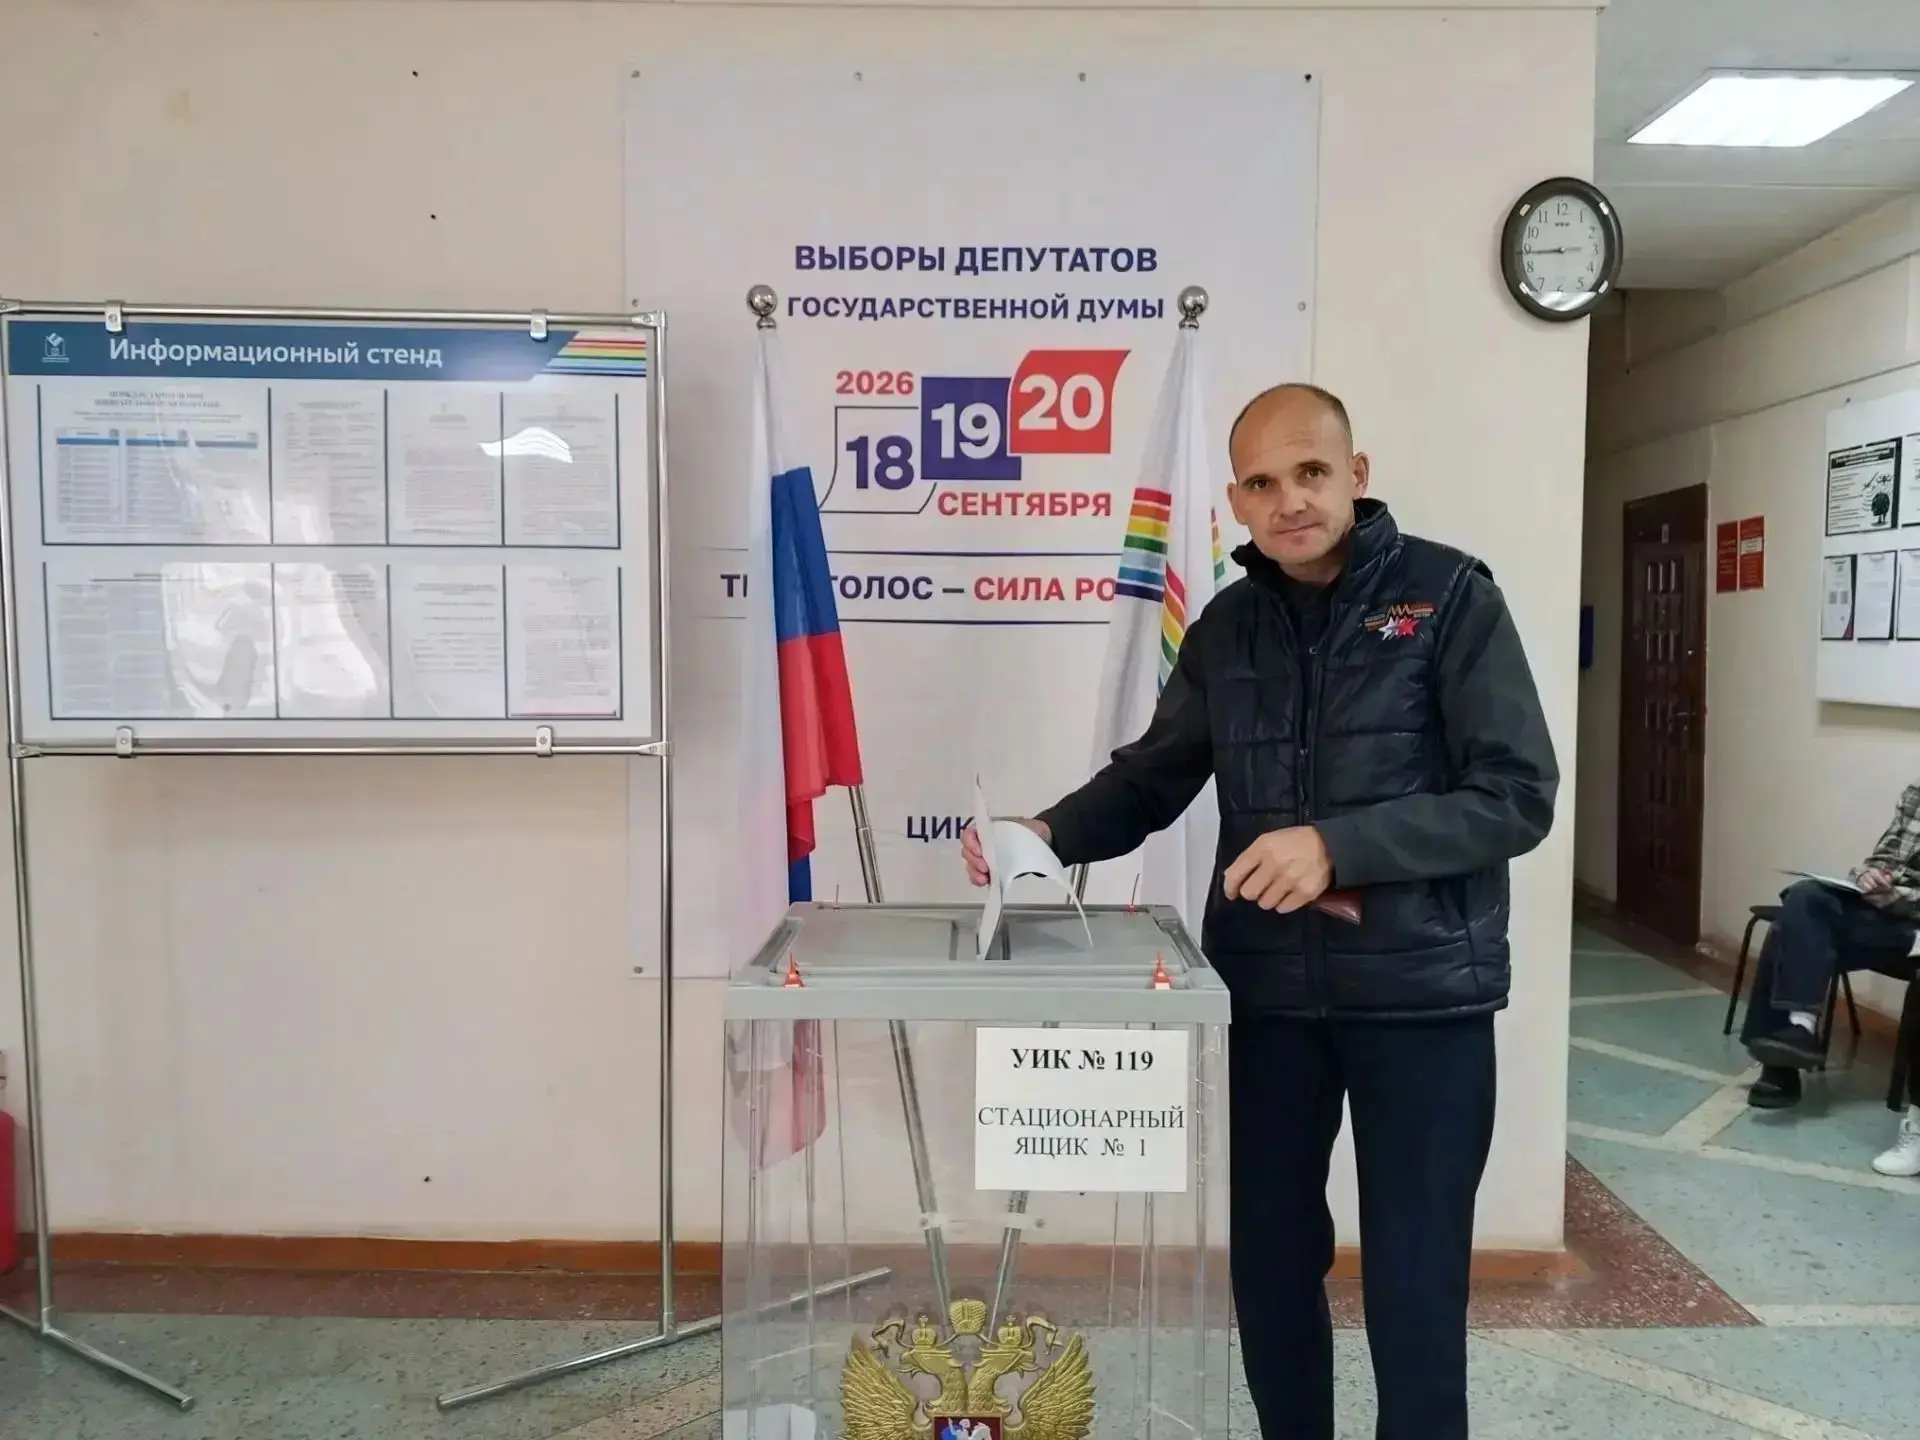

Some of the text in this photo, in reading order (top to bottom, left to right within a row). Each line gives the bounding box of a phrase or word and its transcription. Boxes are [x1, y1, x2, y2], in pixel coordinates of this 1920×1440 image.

[1556, 202, 1571, 216] 12
[795, 245, 1158, 276] ВЫБОРЫ ДЕПУТАТОВ
[787, 294, 1164, 323] ГОСУДАРСТВЕННОЙ ДУМЫ
[108, 333, 444, 370] Информационный стенд
[835, 370, 914, 396] 2026
[846, 373, 1105, 490] 18 19 20
[937, 492, 1111, 517] СЕНТЯБРЯ
[974, 576, 1065, 602] СИЛА
[906, 815, 976, 843] ЦИК
[1011, 1048, 1154, 1071] УИК № 119
[977, 1105, 1185, 1130] СТАЦИОНАРНЫЙ
[1014, 1137, 1147, 1158] ЯЩИК № 1
